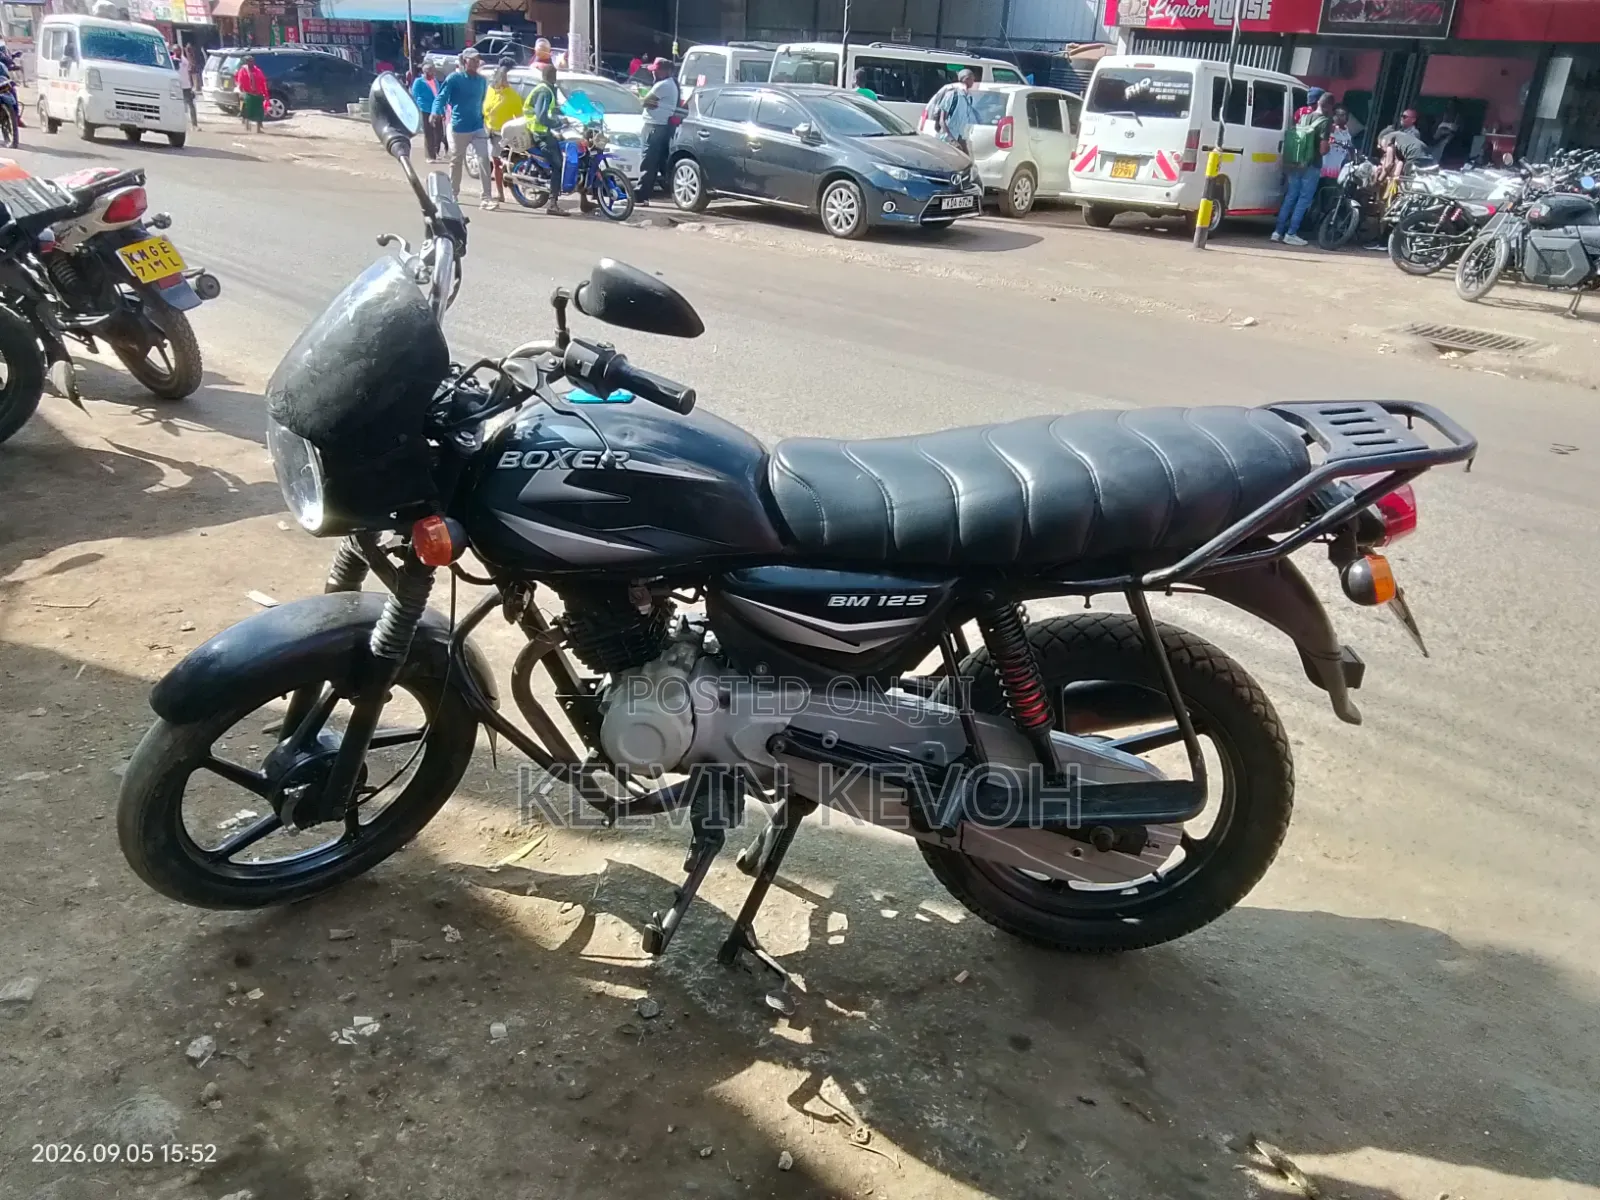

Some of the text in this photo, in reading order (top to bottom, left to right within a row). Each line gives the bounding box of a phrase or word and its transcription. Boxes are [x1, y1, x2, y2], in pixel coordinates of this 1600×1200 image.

[1149, 0, 1208, 25] Liquor
[496, 448, 631, 470] BOXER
[827, 594, 928, 607] BM 125
